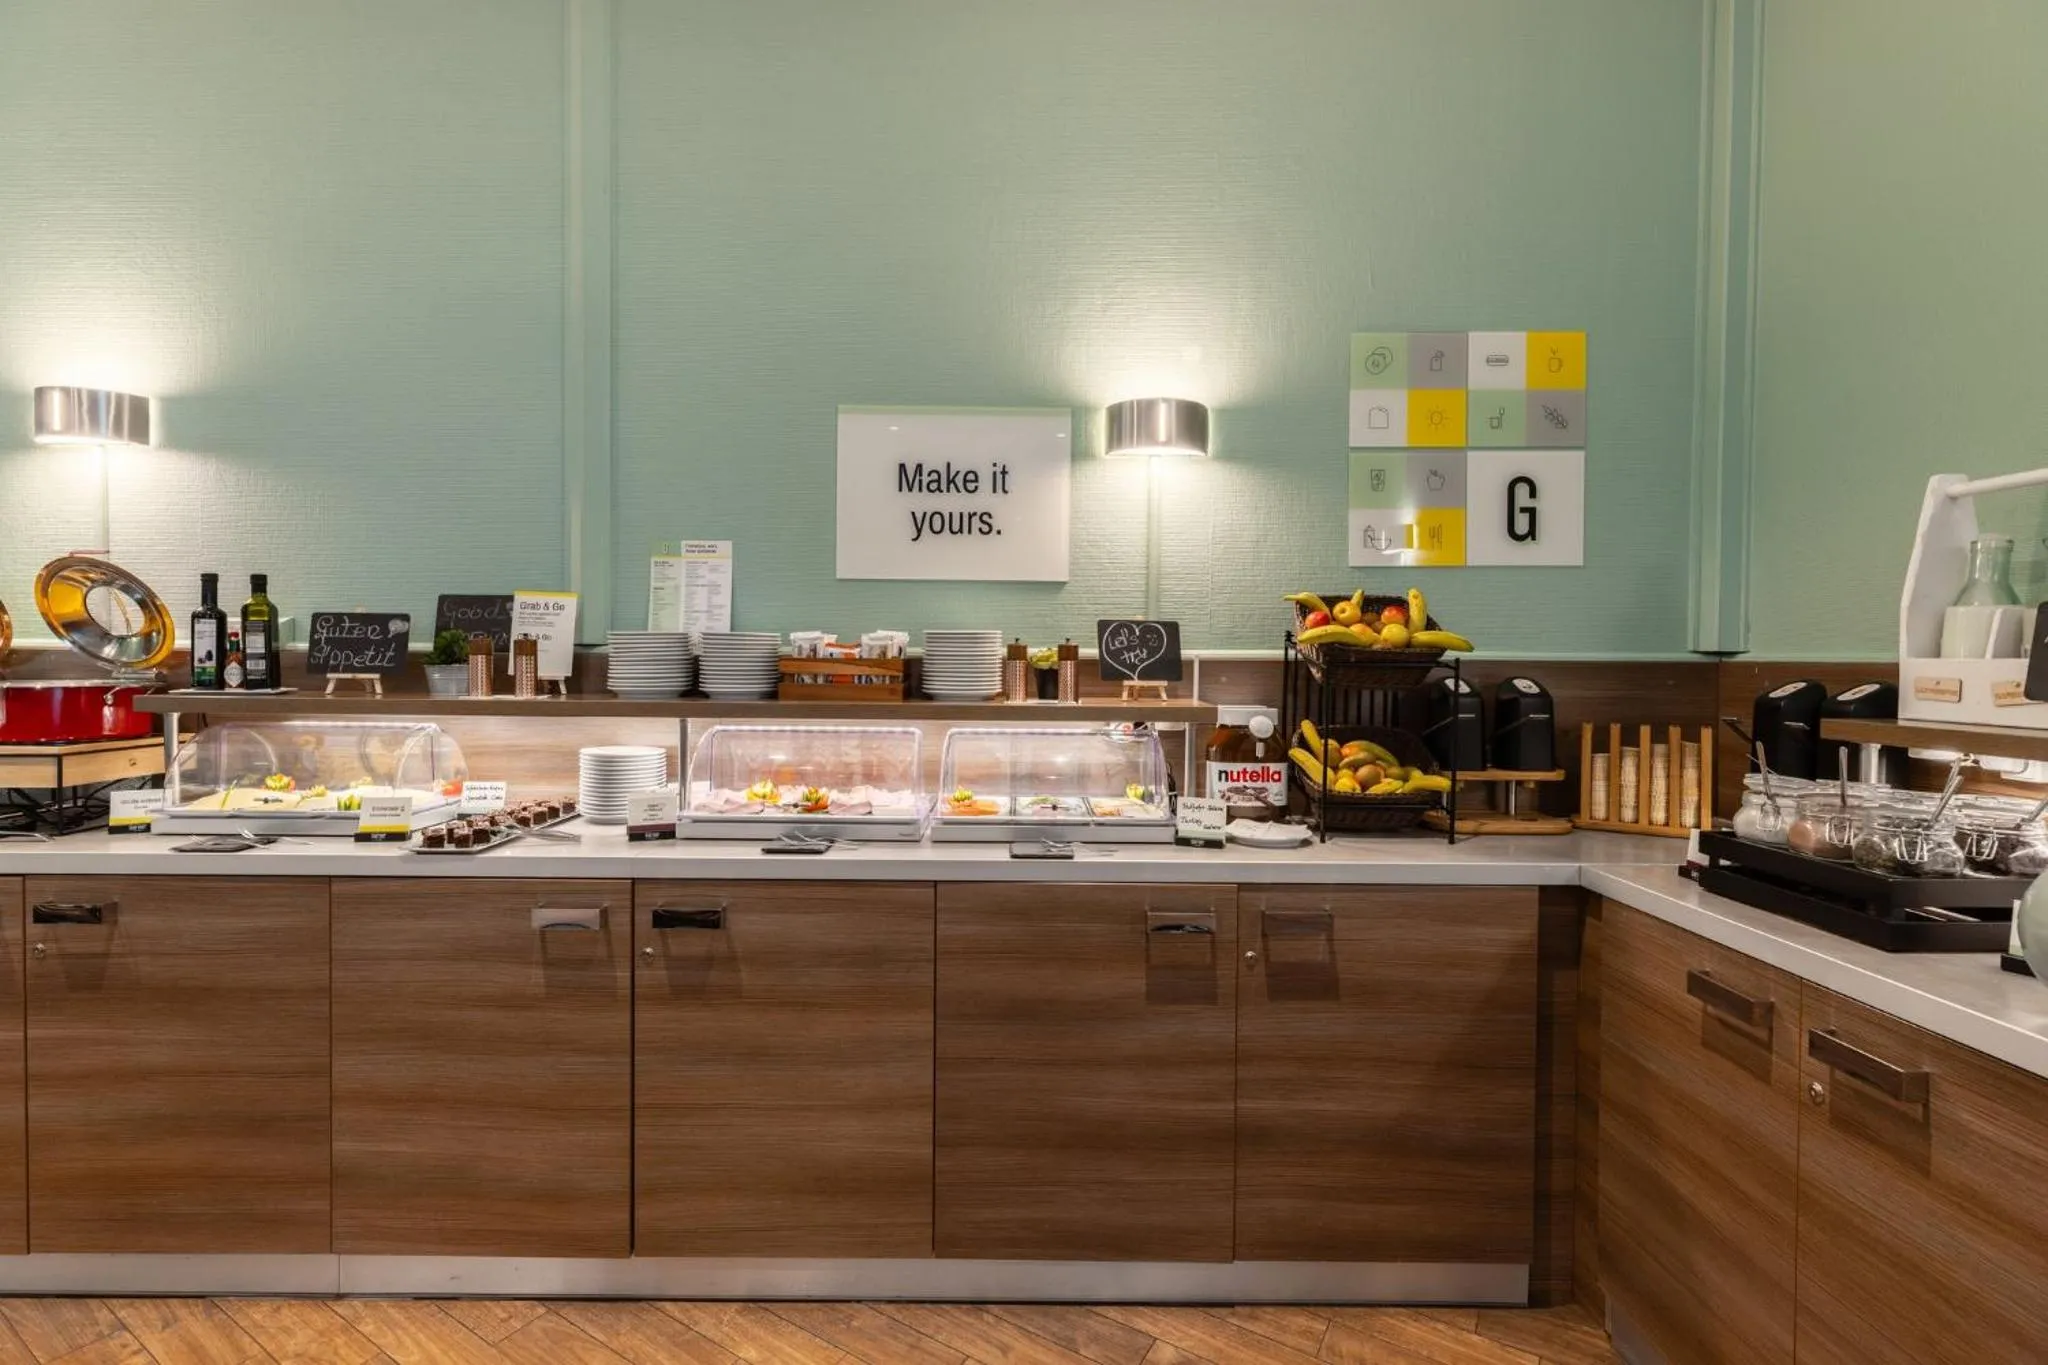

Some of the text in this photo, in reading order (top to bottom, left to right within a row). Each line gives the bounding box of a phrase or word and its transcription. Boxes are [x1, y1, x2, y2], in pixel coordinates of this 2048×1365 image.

[898, 461, 1009, 495] Make it
[1506, 475, 1538, 543] G
[910, 510, 1002, 542] yours.
[519, 601, 566, 613] Grab & Go
[314, 615, 384, 645] Guten
[310, 642, 397, 672] Appetit
[1217, 765, 1283, 783] nutella
